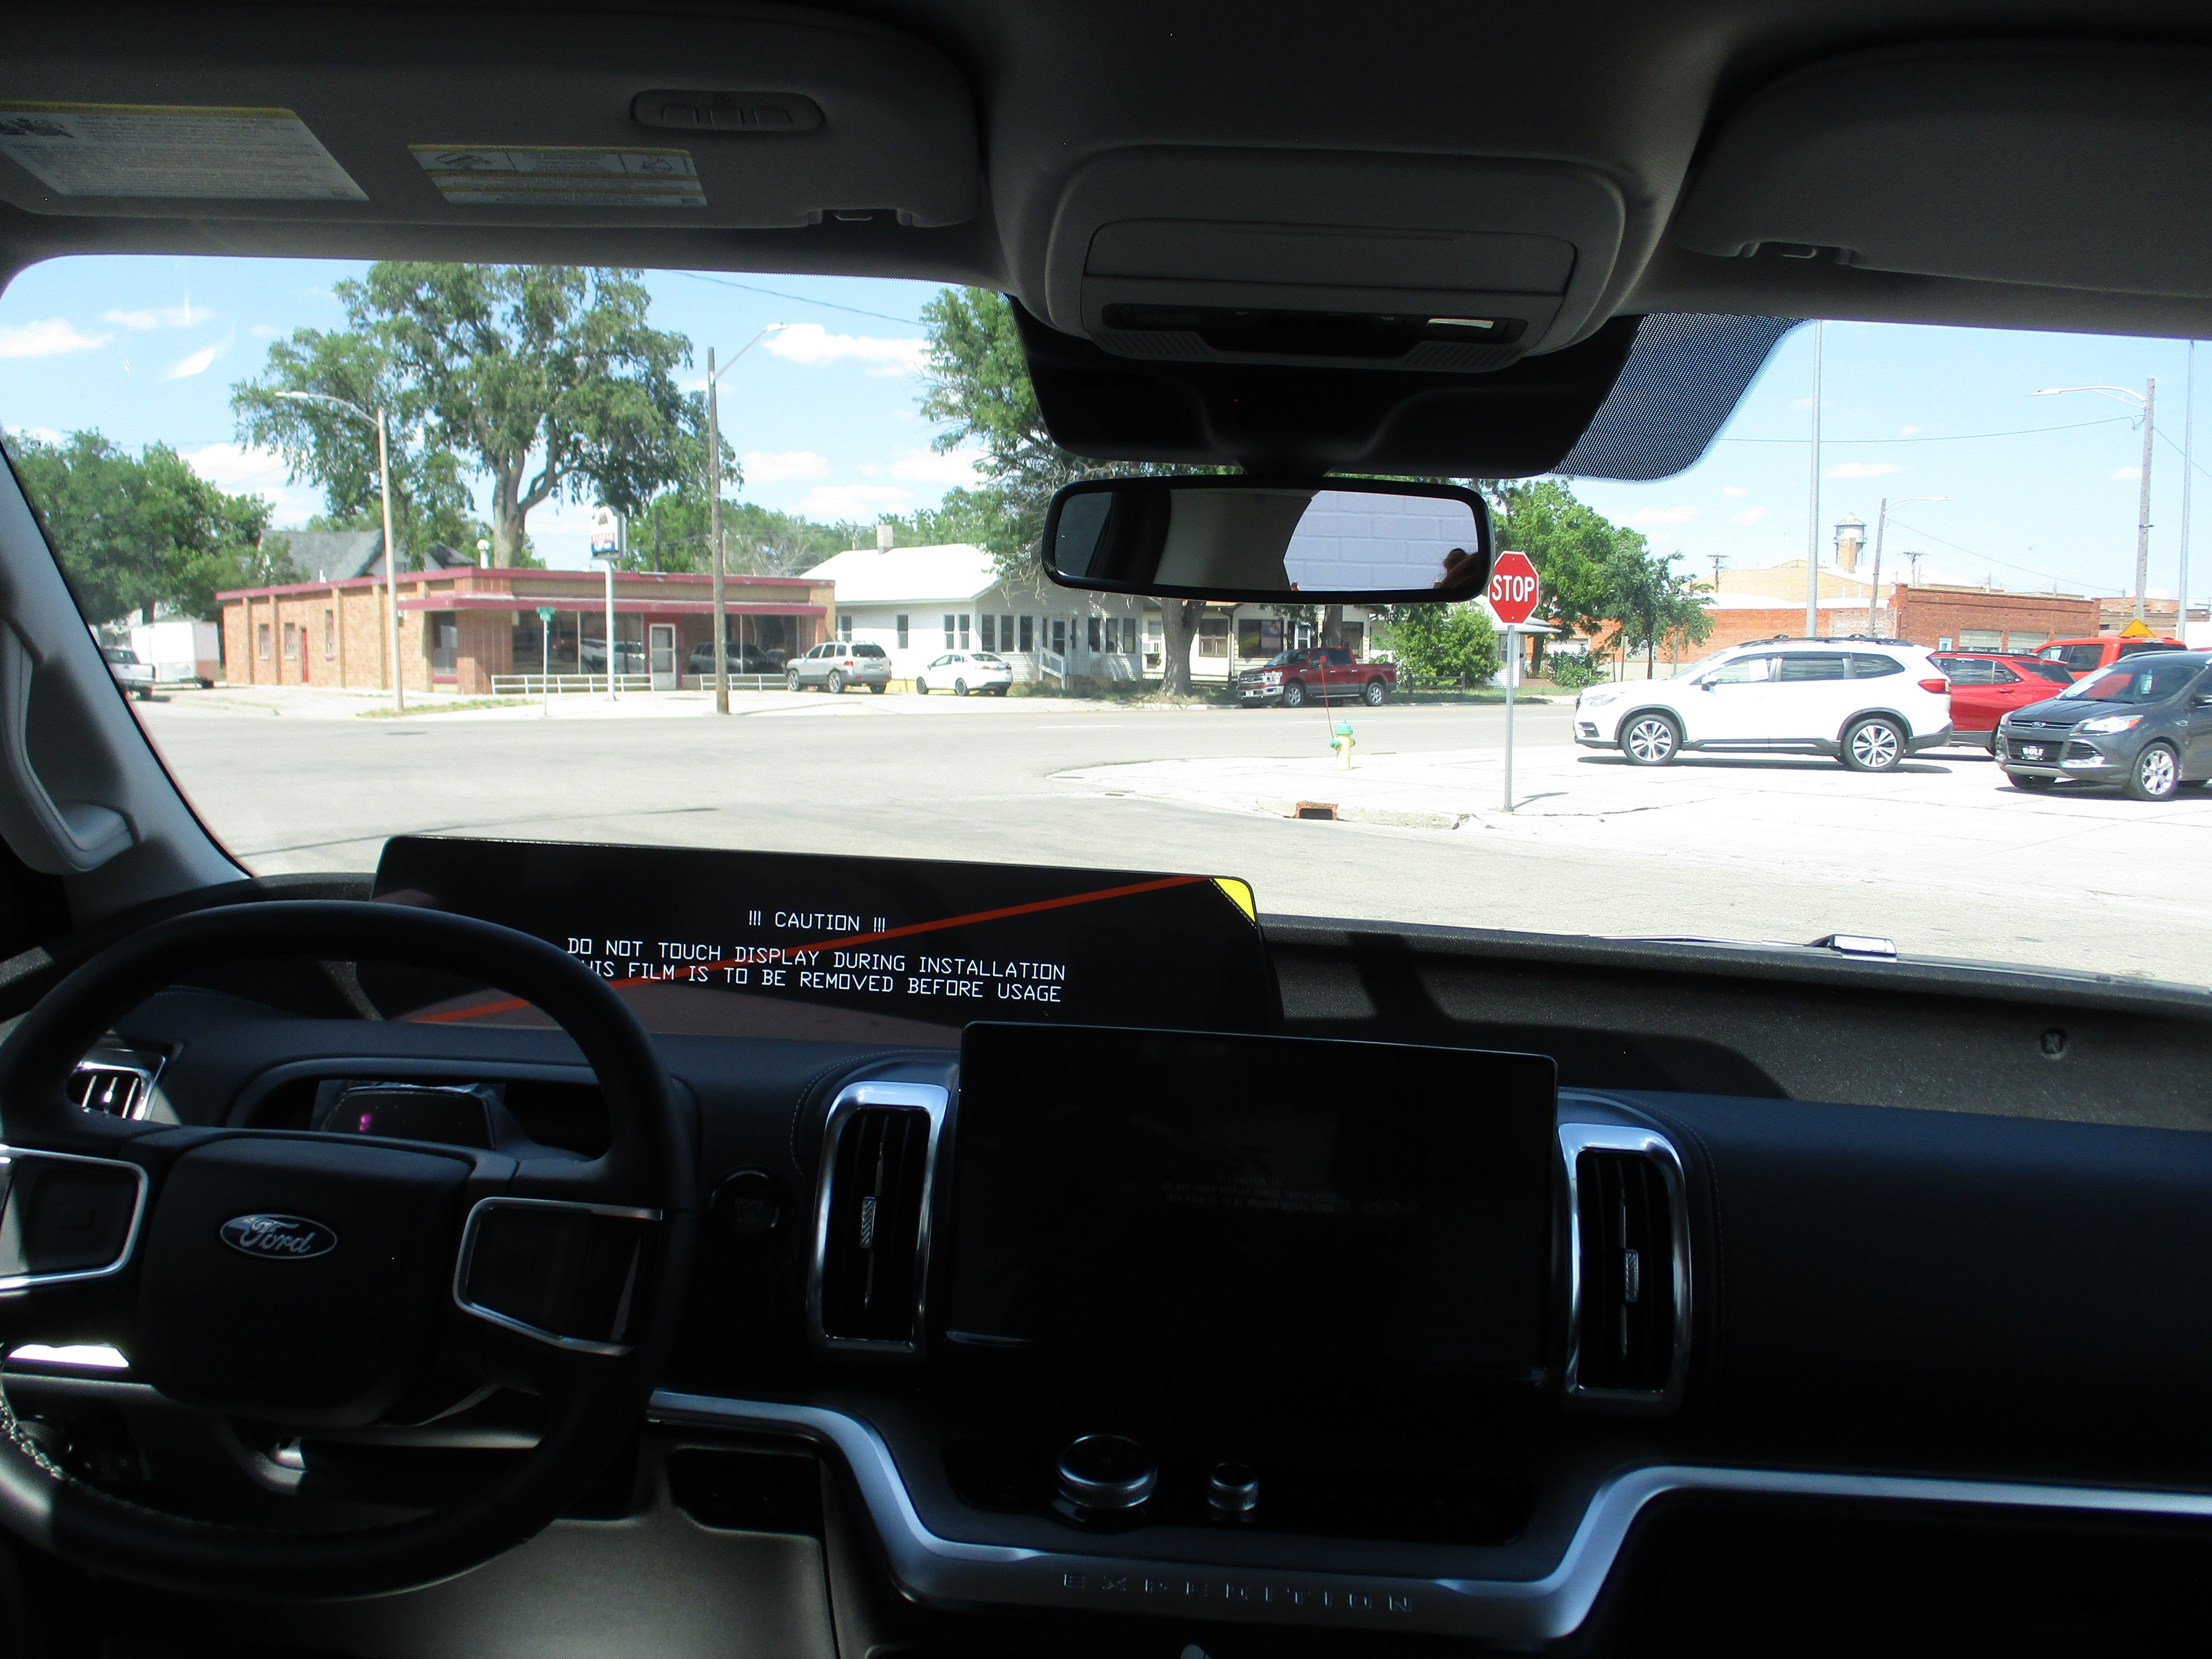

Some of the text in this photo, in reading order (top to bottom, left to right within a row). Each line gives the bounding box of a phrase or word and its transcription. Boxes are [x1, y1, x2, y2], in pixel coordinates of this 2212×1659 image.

[1491, 574, 1535, 602] STOP
[2022, 747, 2044, 756] WOLF
[775, 911, 860, 932] CAUTION
[567, 938, 1065, 981] DO NOT TOUCH DISPLAY DURING INSTALLATION
[629, 962, 675, 981] FILM
[688, 965, 708, 983] IS
[723, 967, 747, 984] TO
[761, 969, 786, 986] BE
[800, 972, 893, 993] REMOVED
[907, 977, 984, 997] BEFORE
[997, 983, 1062, 1003] USAGE
[240, 1218, 316, 1253] Ford
[1063, 1573, 1413, 1613] EXPEDITION
